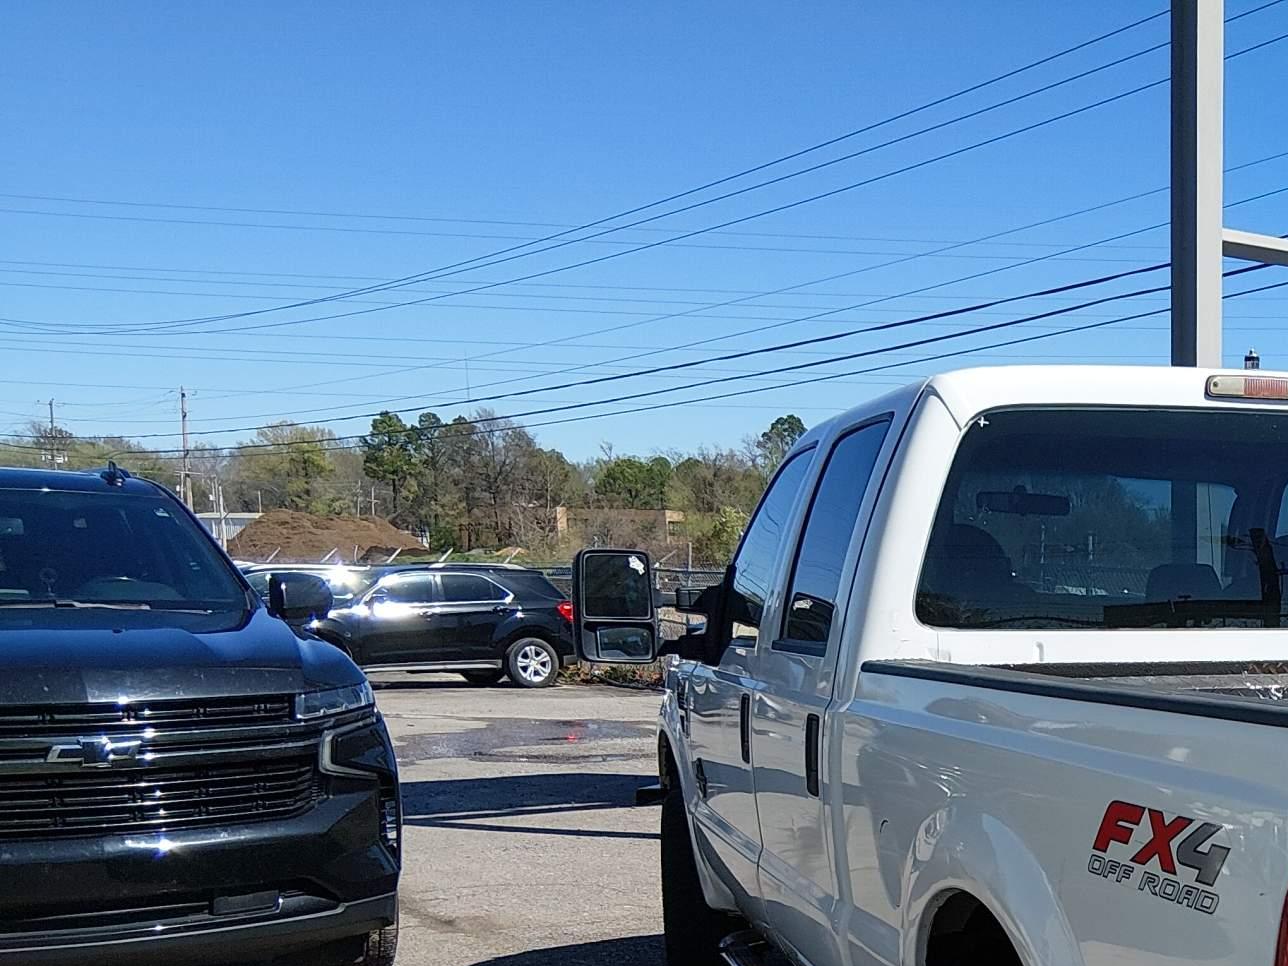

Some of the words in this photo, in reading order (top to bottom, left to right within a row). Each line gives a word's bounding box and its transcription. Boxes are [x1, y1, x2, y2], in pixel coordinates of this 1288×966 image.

[1092, 800, 1231, 887] FX4
[1087, 853, 1135, 883] OFF
[1137, 871, 1220, 915] ROAD
